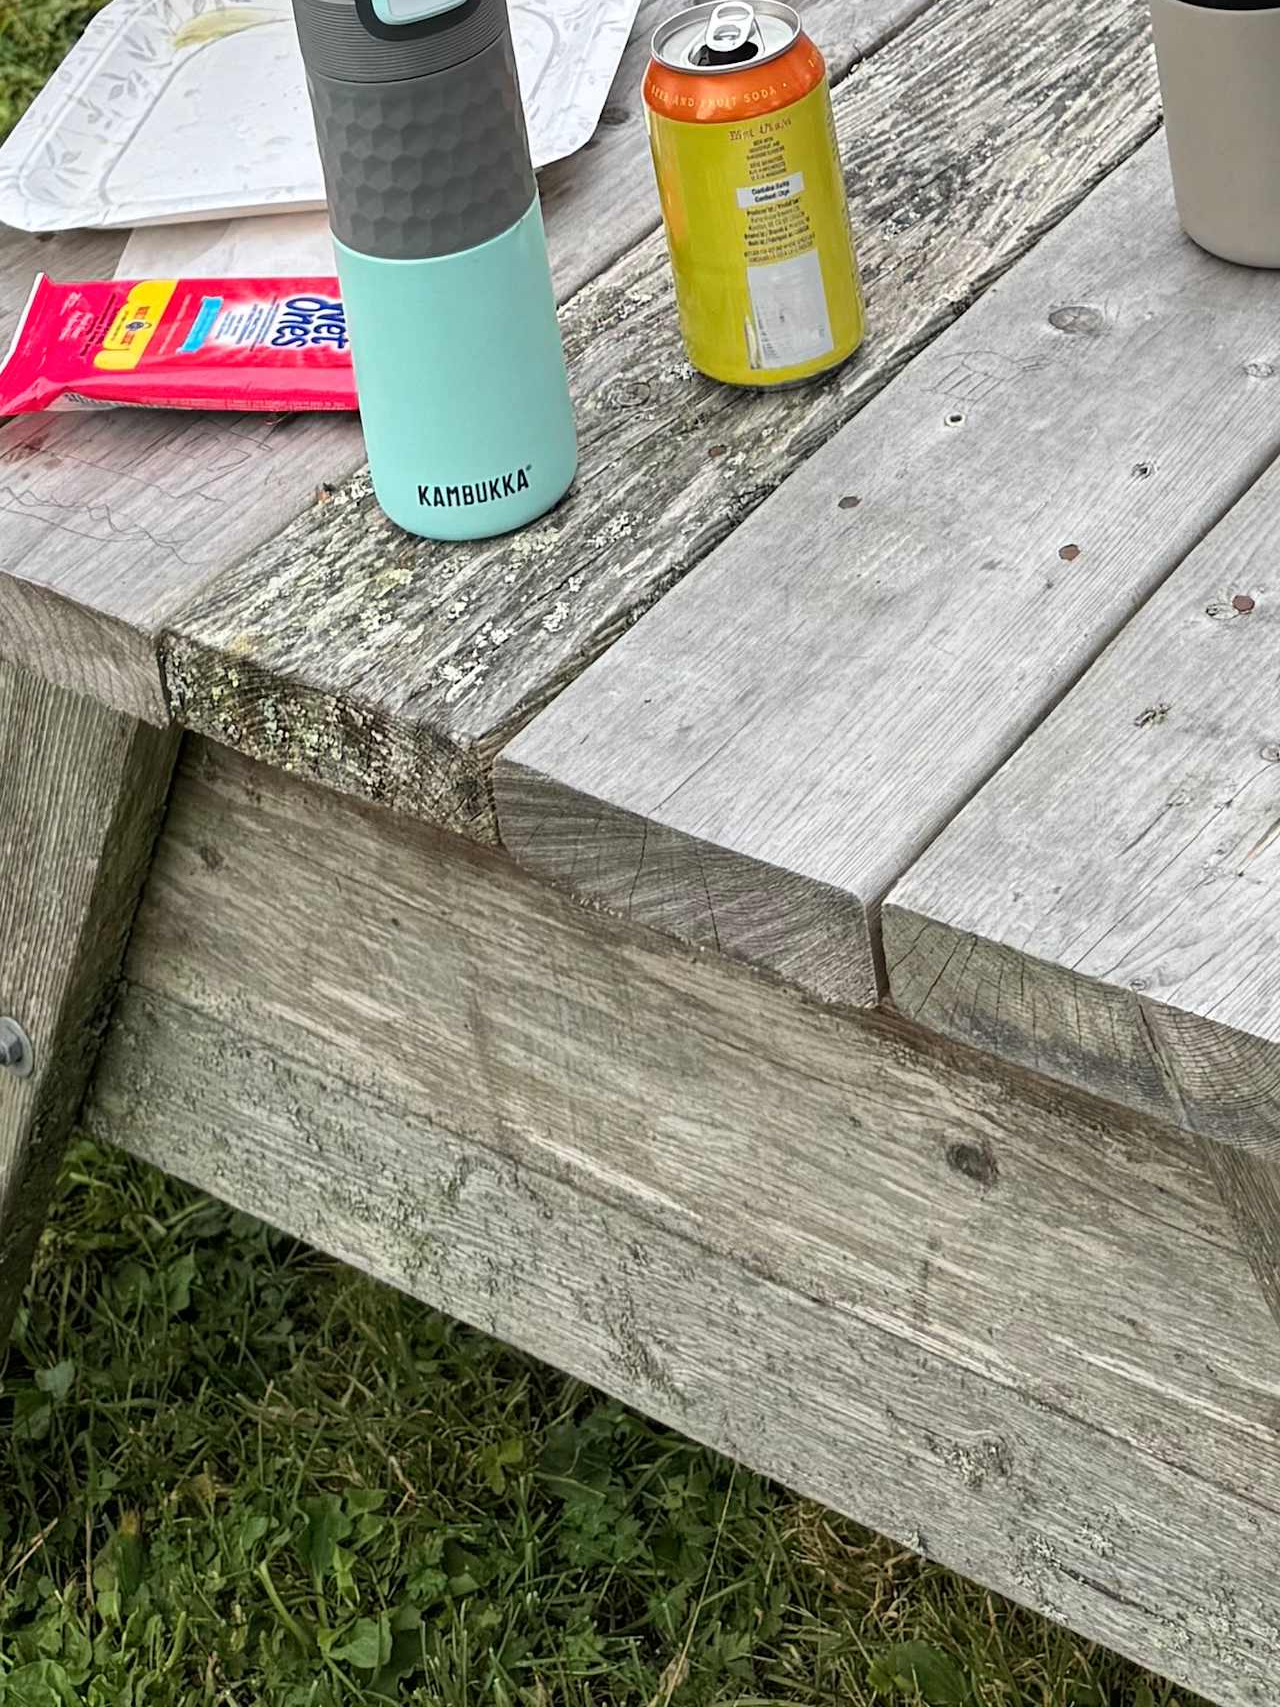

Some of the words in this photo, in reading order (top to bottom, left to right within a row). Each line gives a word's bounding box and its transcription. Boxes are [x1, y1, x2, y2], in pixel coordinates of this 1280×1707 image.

[743, 85, 777, 104] SODA
[271, 297, 328, 348] Ones
[417, 467, 530, 508] KAMBUKKA
